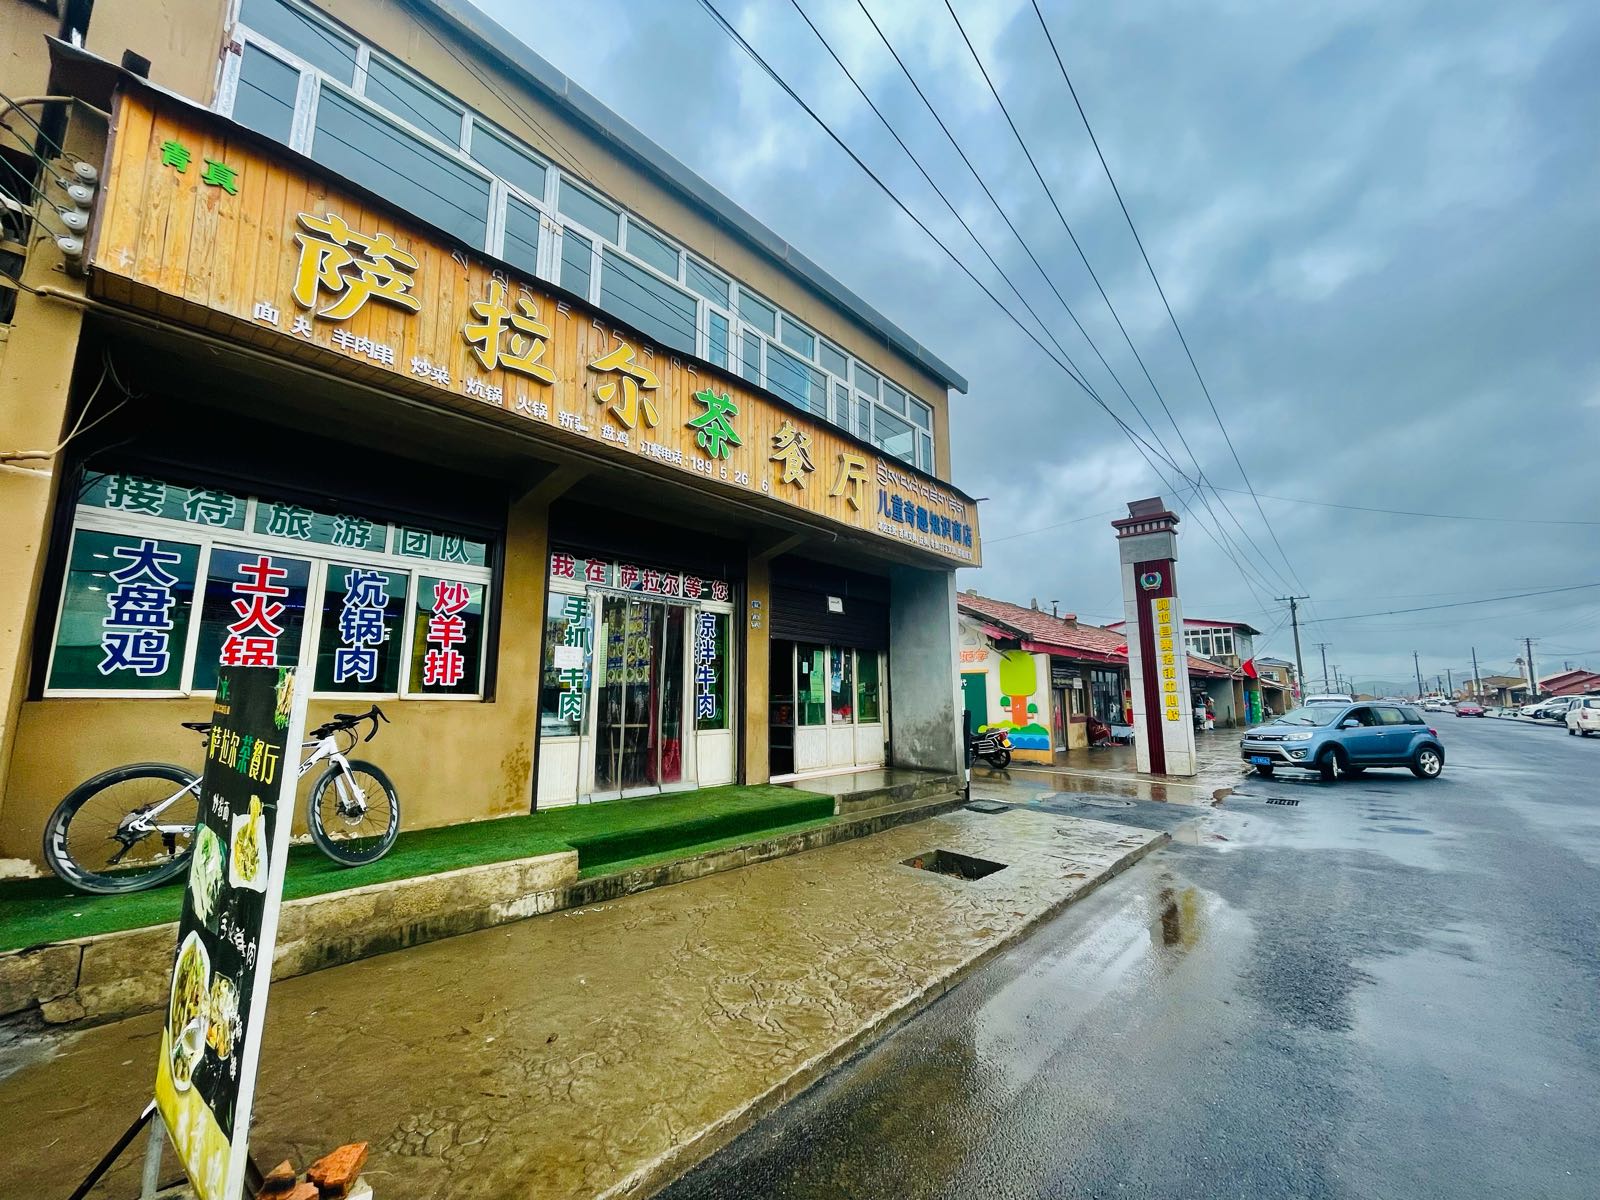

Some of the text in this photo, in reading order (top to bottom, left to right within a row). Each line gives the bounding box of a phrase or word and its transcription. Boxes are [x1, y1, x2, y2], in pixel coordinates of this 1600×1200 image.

[290, 211, 869, 514] 萨拉尔茶餐厅
[331, 328, 394, 366] 羊肉串
[516, 395, 549, 421] 火锅
[105, 470, 472, 566] 接待旅游团队
[877, 488, 973, 549] 儿童奇趣知识商店
[97, 538, 182, 679] 大盘鸡
[220, 555, 290, 666] 土火锅
[333, 569, 390, 684] 炕锅肉
[551, 552, 730, 602] 我在萨拉尔等您
[424, 580, 472, 687] 炒羊排
[209, 724, 281, 786] 萨拉尔茶餐厅
